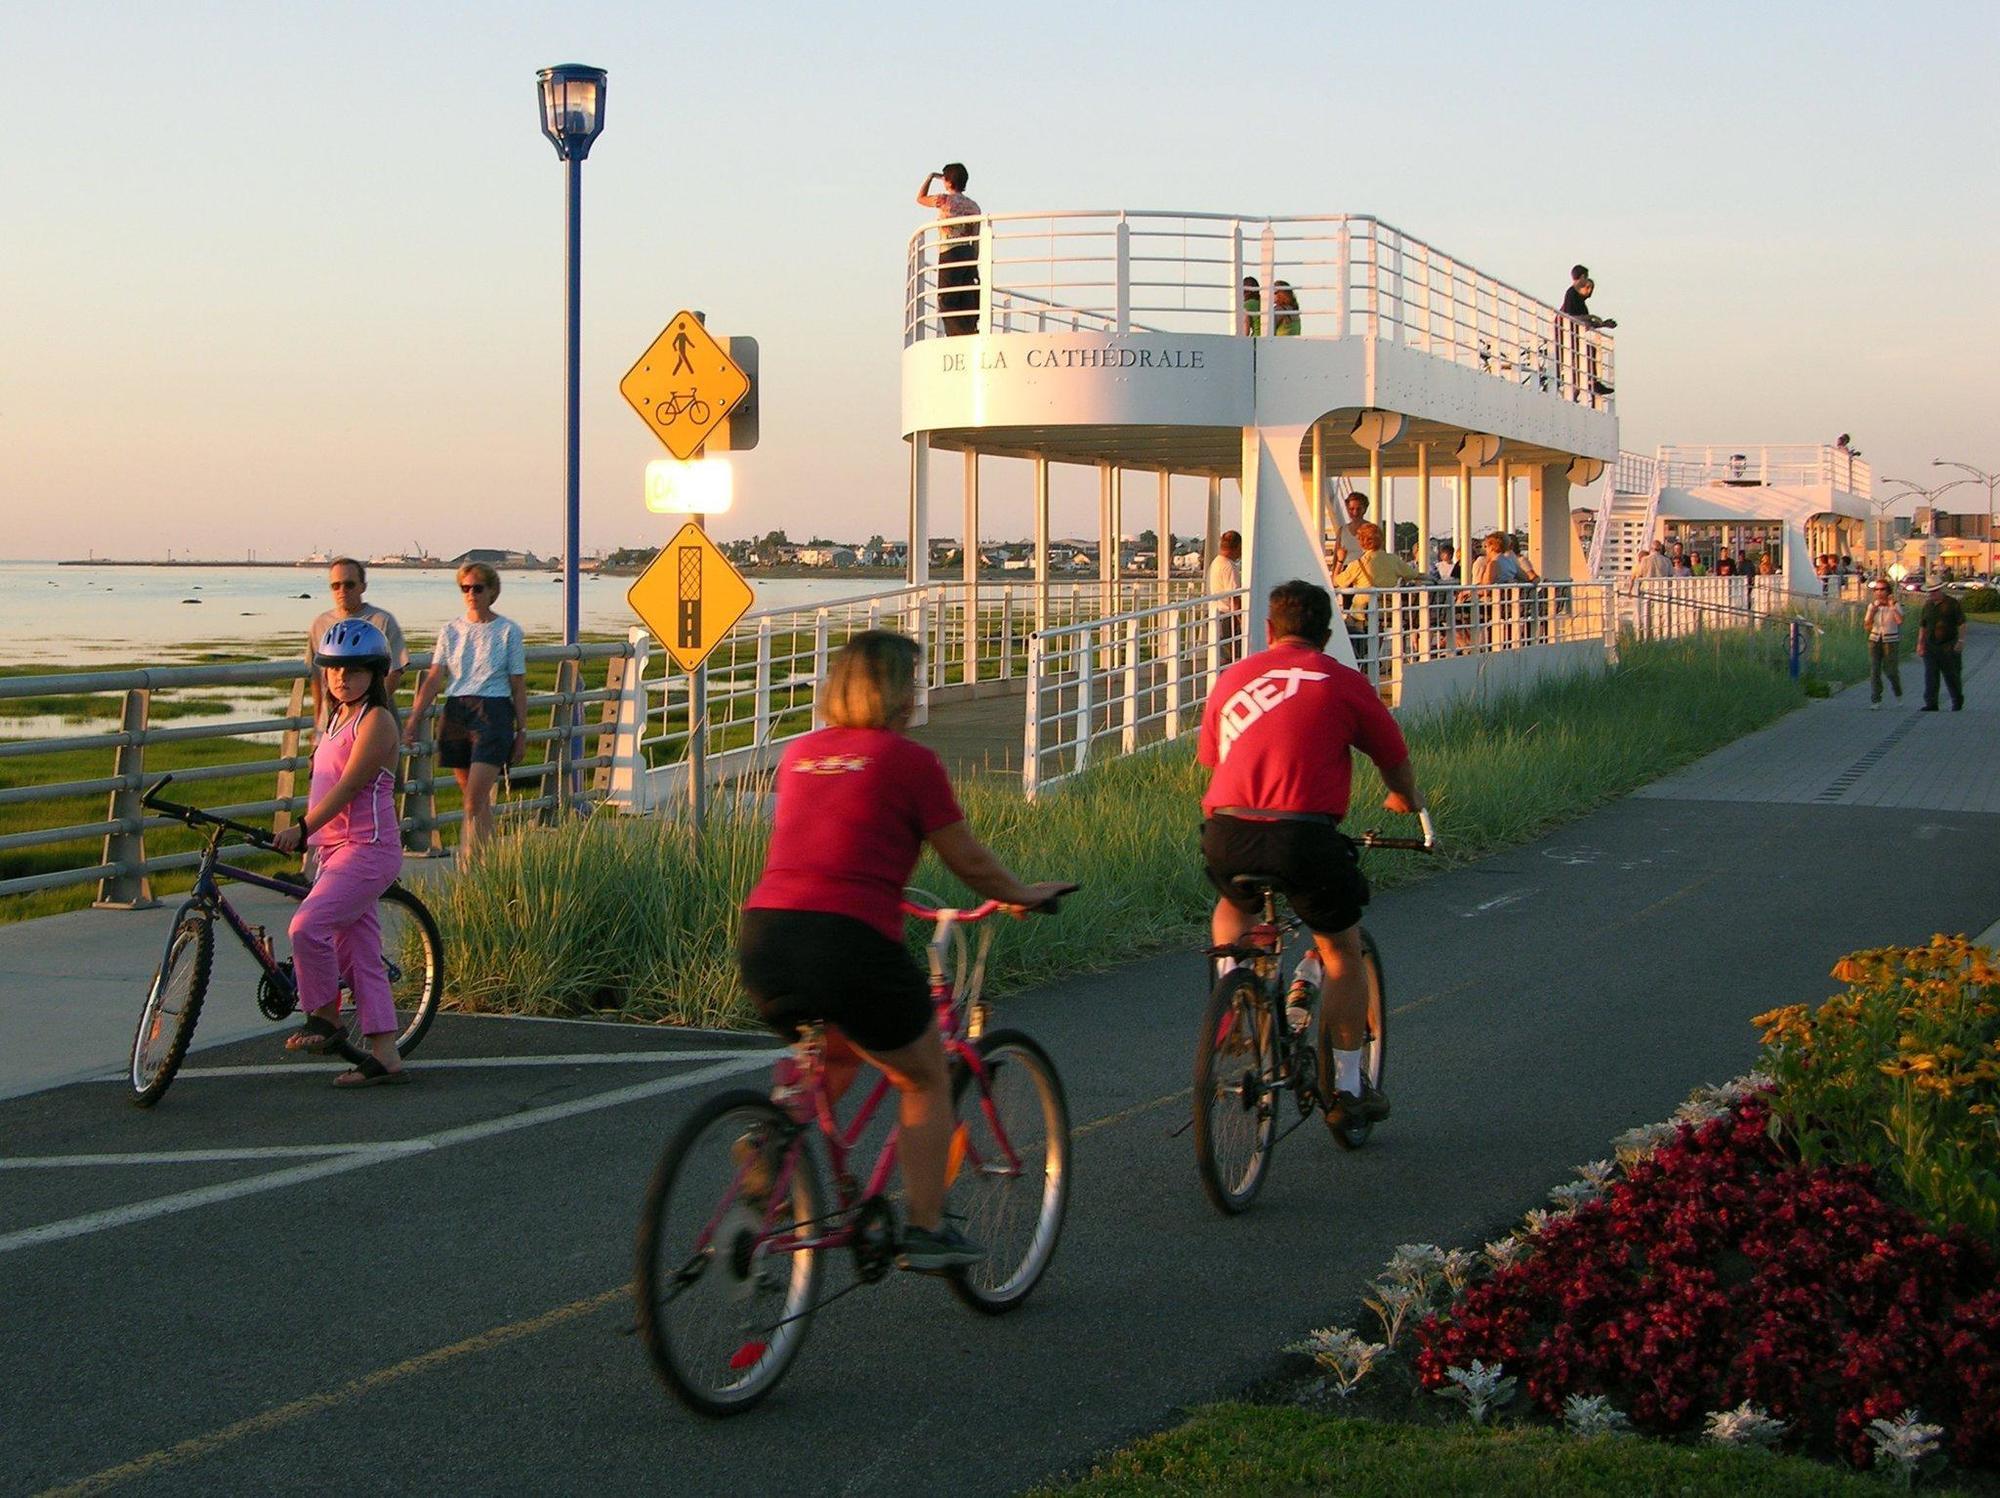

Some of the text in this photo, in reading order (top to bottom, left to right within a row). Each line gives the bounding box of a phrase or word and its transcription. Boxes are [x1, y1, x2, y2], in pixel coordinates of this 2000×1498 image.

[943, 342, 1205, 372] DE LA CATHÉDRALE
